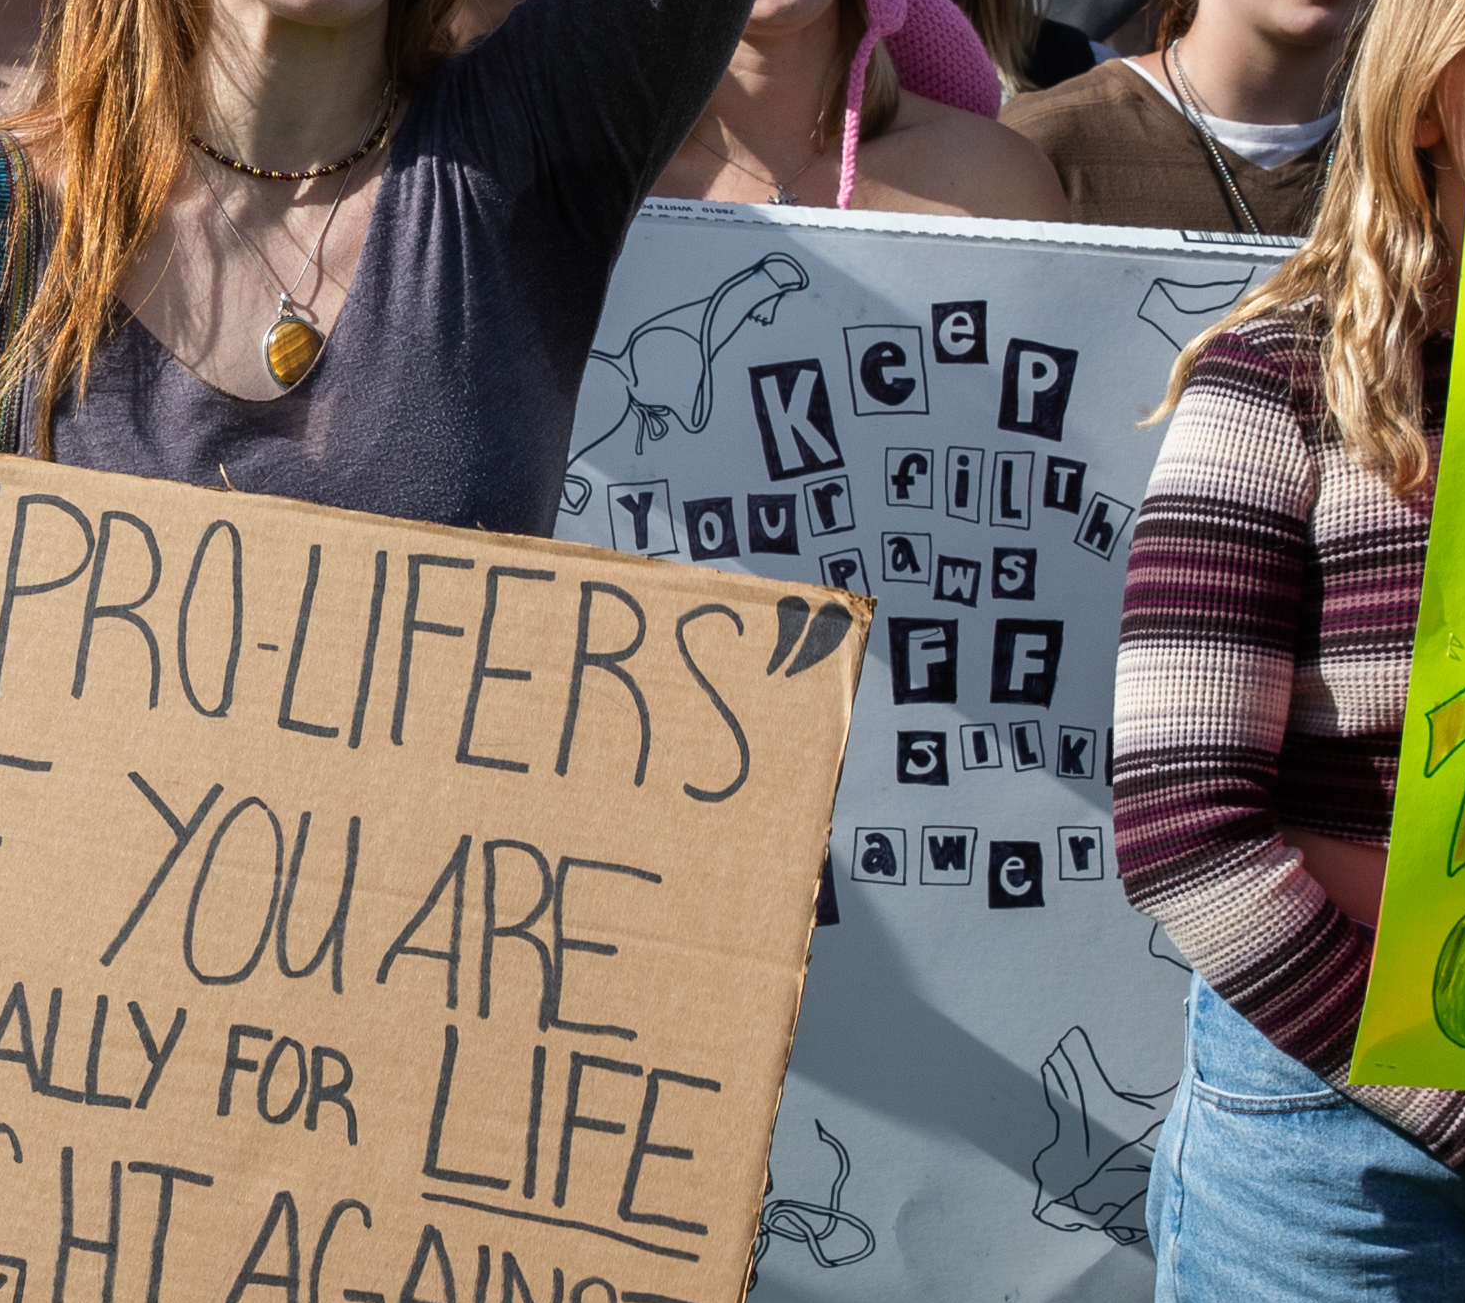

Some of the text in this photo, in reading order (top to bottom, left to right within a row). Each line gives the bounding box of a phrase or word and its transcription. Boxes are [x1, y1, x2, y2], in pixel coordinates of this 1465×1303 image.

[99, 770, 361, 995] YOU
[376, 834, 663, 1041] ARE
[216, 1025, 358, 1147] FOR
[421, 1025, 722, 1234] LIFE
